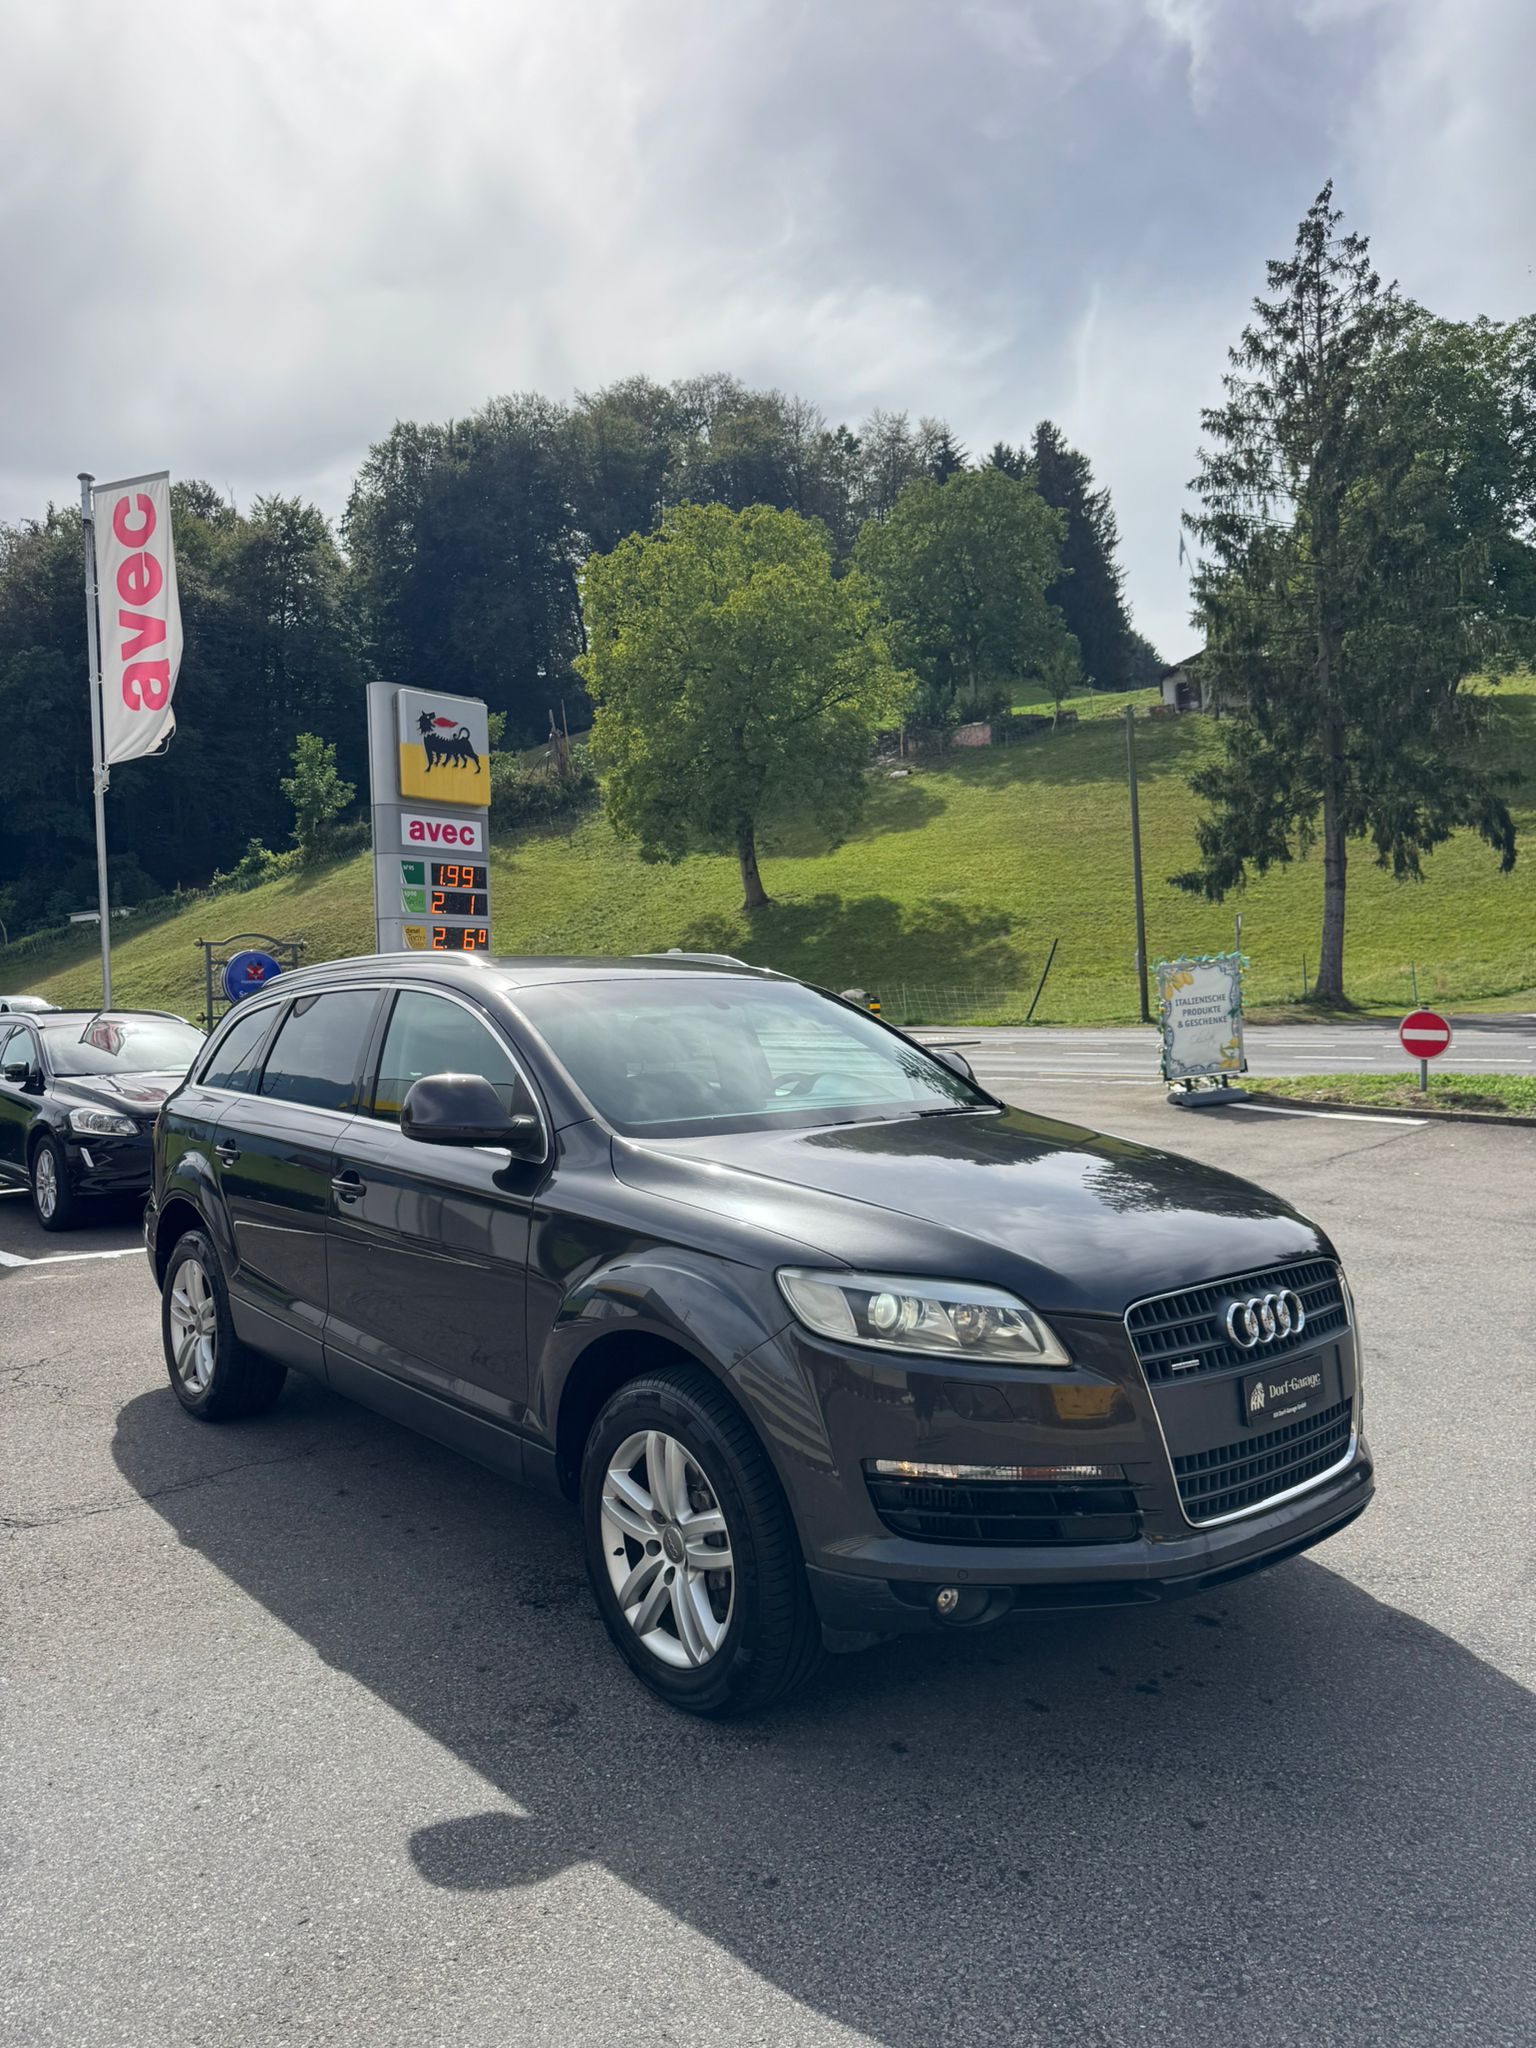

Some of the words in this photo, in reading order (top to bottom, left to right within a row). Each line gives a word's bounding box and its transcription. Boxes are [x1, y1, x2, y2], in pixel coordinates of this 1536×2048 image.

[112, 493, 171, 712] avec
[409, 820, 475, 846] avec
[1175, 993, 1226, 1007] ITALIENISCHE
[1182, 1005, 1221, 1017] PRODUKTE
[1185, 1015, 1227, 1028] GESCHENKE
